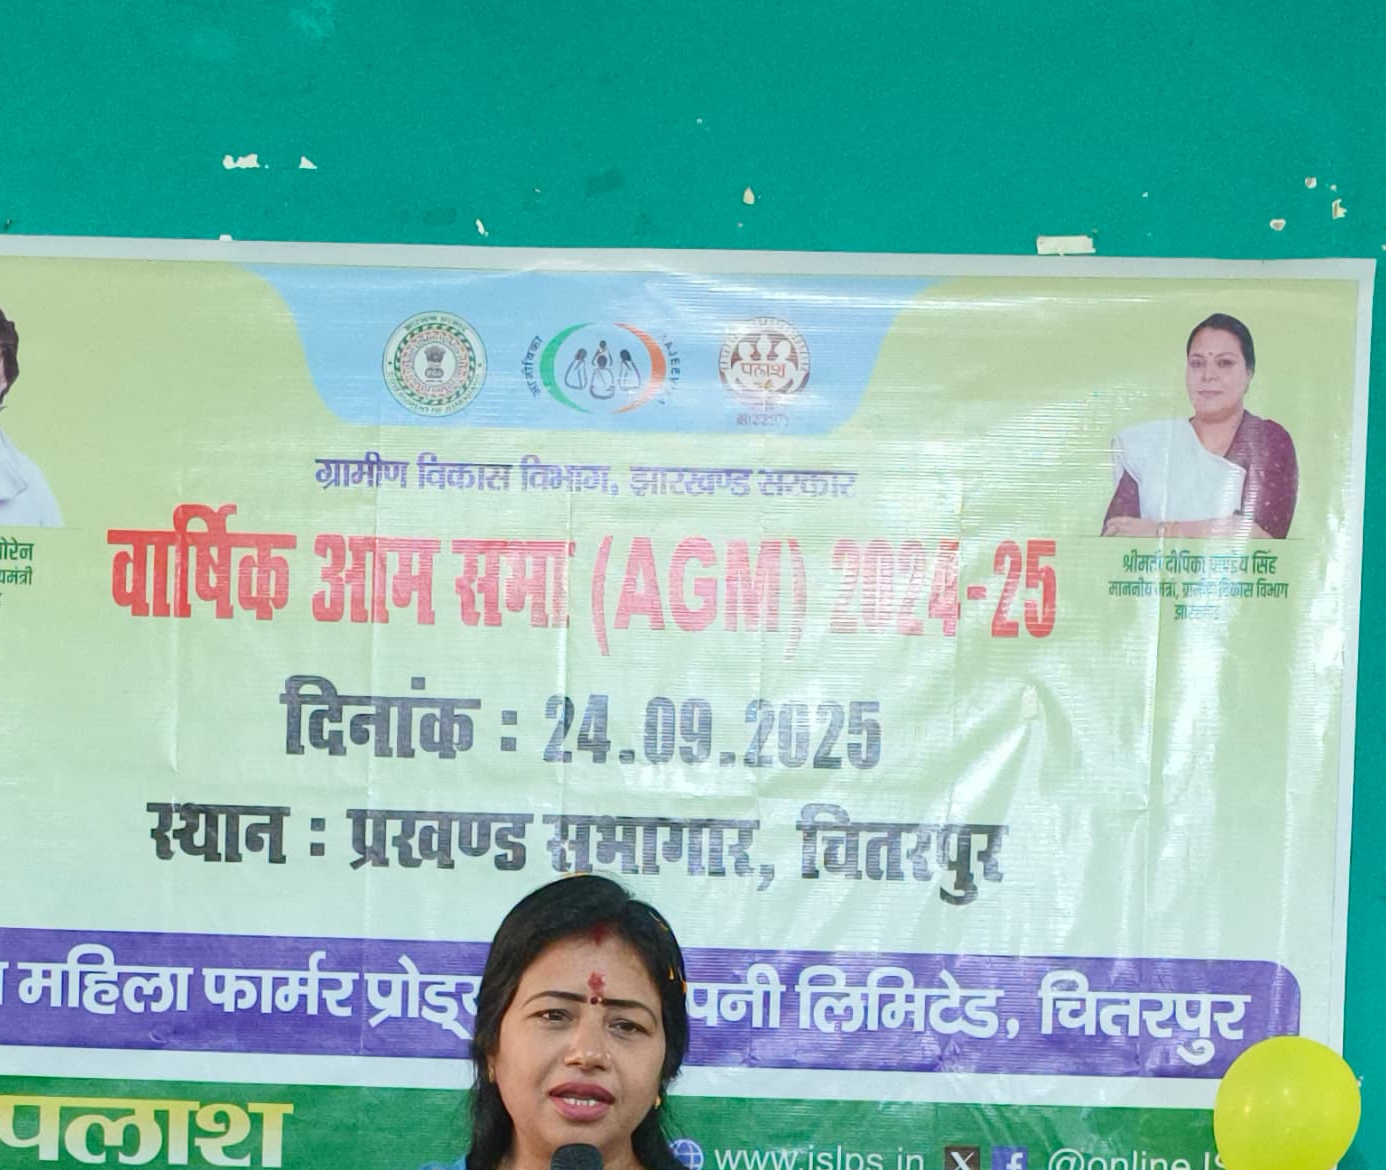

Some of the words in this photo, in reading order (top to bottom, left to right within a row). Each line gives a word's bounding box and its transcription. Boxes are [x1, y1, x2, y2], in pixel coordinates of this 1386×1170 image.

[315, 451, 409, 490] ग्रामीण
[416, 451, 513, 491] विकास
[519, 454, 620, 496] विभाग,
[629, 467, 753, 497] झारखण्ड
[758, 467, 857, 500] सरकार
[107, 503, 297, 621] वार्षिक
[312, 533, 441, 627] आम
[593, 533, 807, 662] (AGM)
[830, 538, 1058, 640] 2024-25
[1252, 549, 1278, 574] सिंह
[1256, 578, 1289, 598] विभाग
[281, 675, 482, 758] दिनांक
[544, 693, 882, 771] 24.09.2025
[147, 802, 291, 865] स्थान
[347, 808, 534, 872] प्रखण्ड
[542, 813, 775, 891] सभागार,
[797, 803, 1008, 902] चितरपुर
[18, 943, 201, 1014] महिला
[204, 950, 360, 1018] फार्मर
[795, 964, 1021, 1041] लिमिटेड,
[1038, 969, 1251, 1065] चितरपुर
